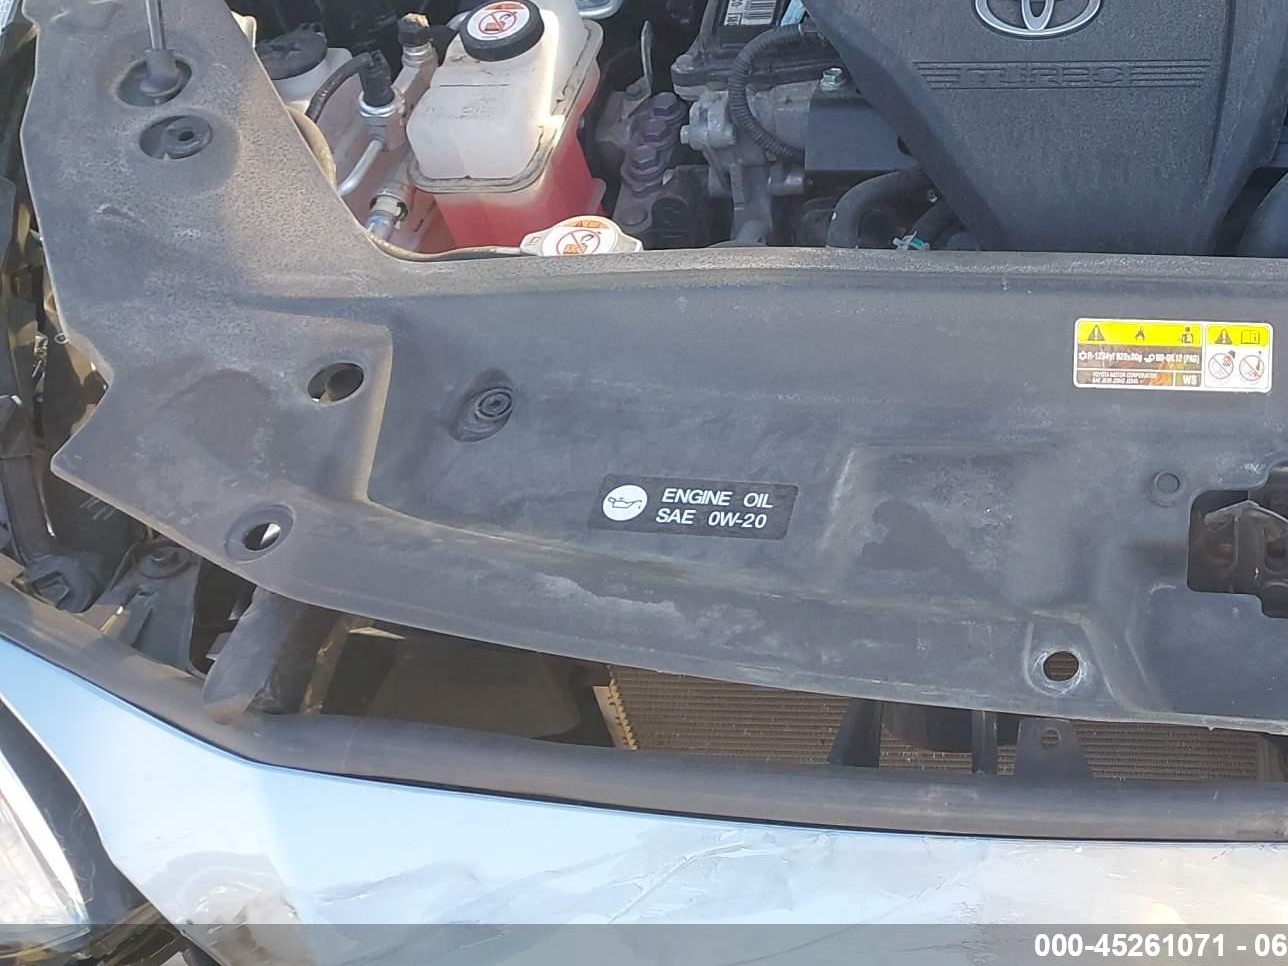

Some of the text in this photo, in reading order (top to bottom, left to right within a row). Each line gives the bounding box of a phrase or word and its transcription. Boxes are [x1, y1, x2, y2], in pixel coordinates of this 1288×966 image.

[1182, 374, 1197, 385] WS
[662, 488, 774, 508] ENGINE OIL
[655, 508, 767, 529] SAE 0W-20
